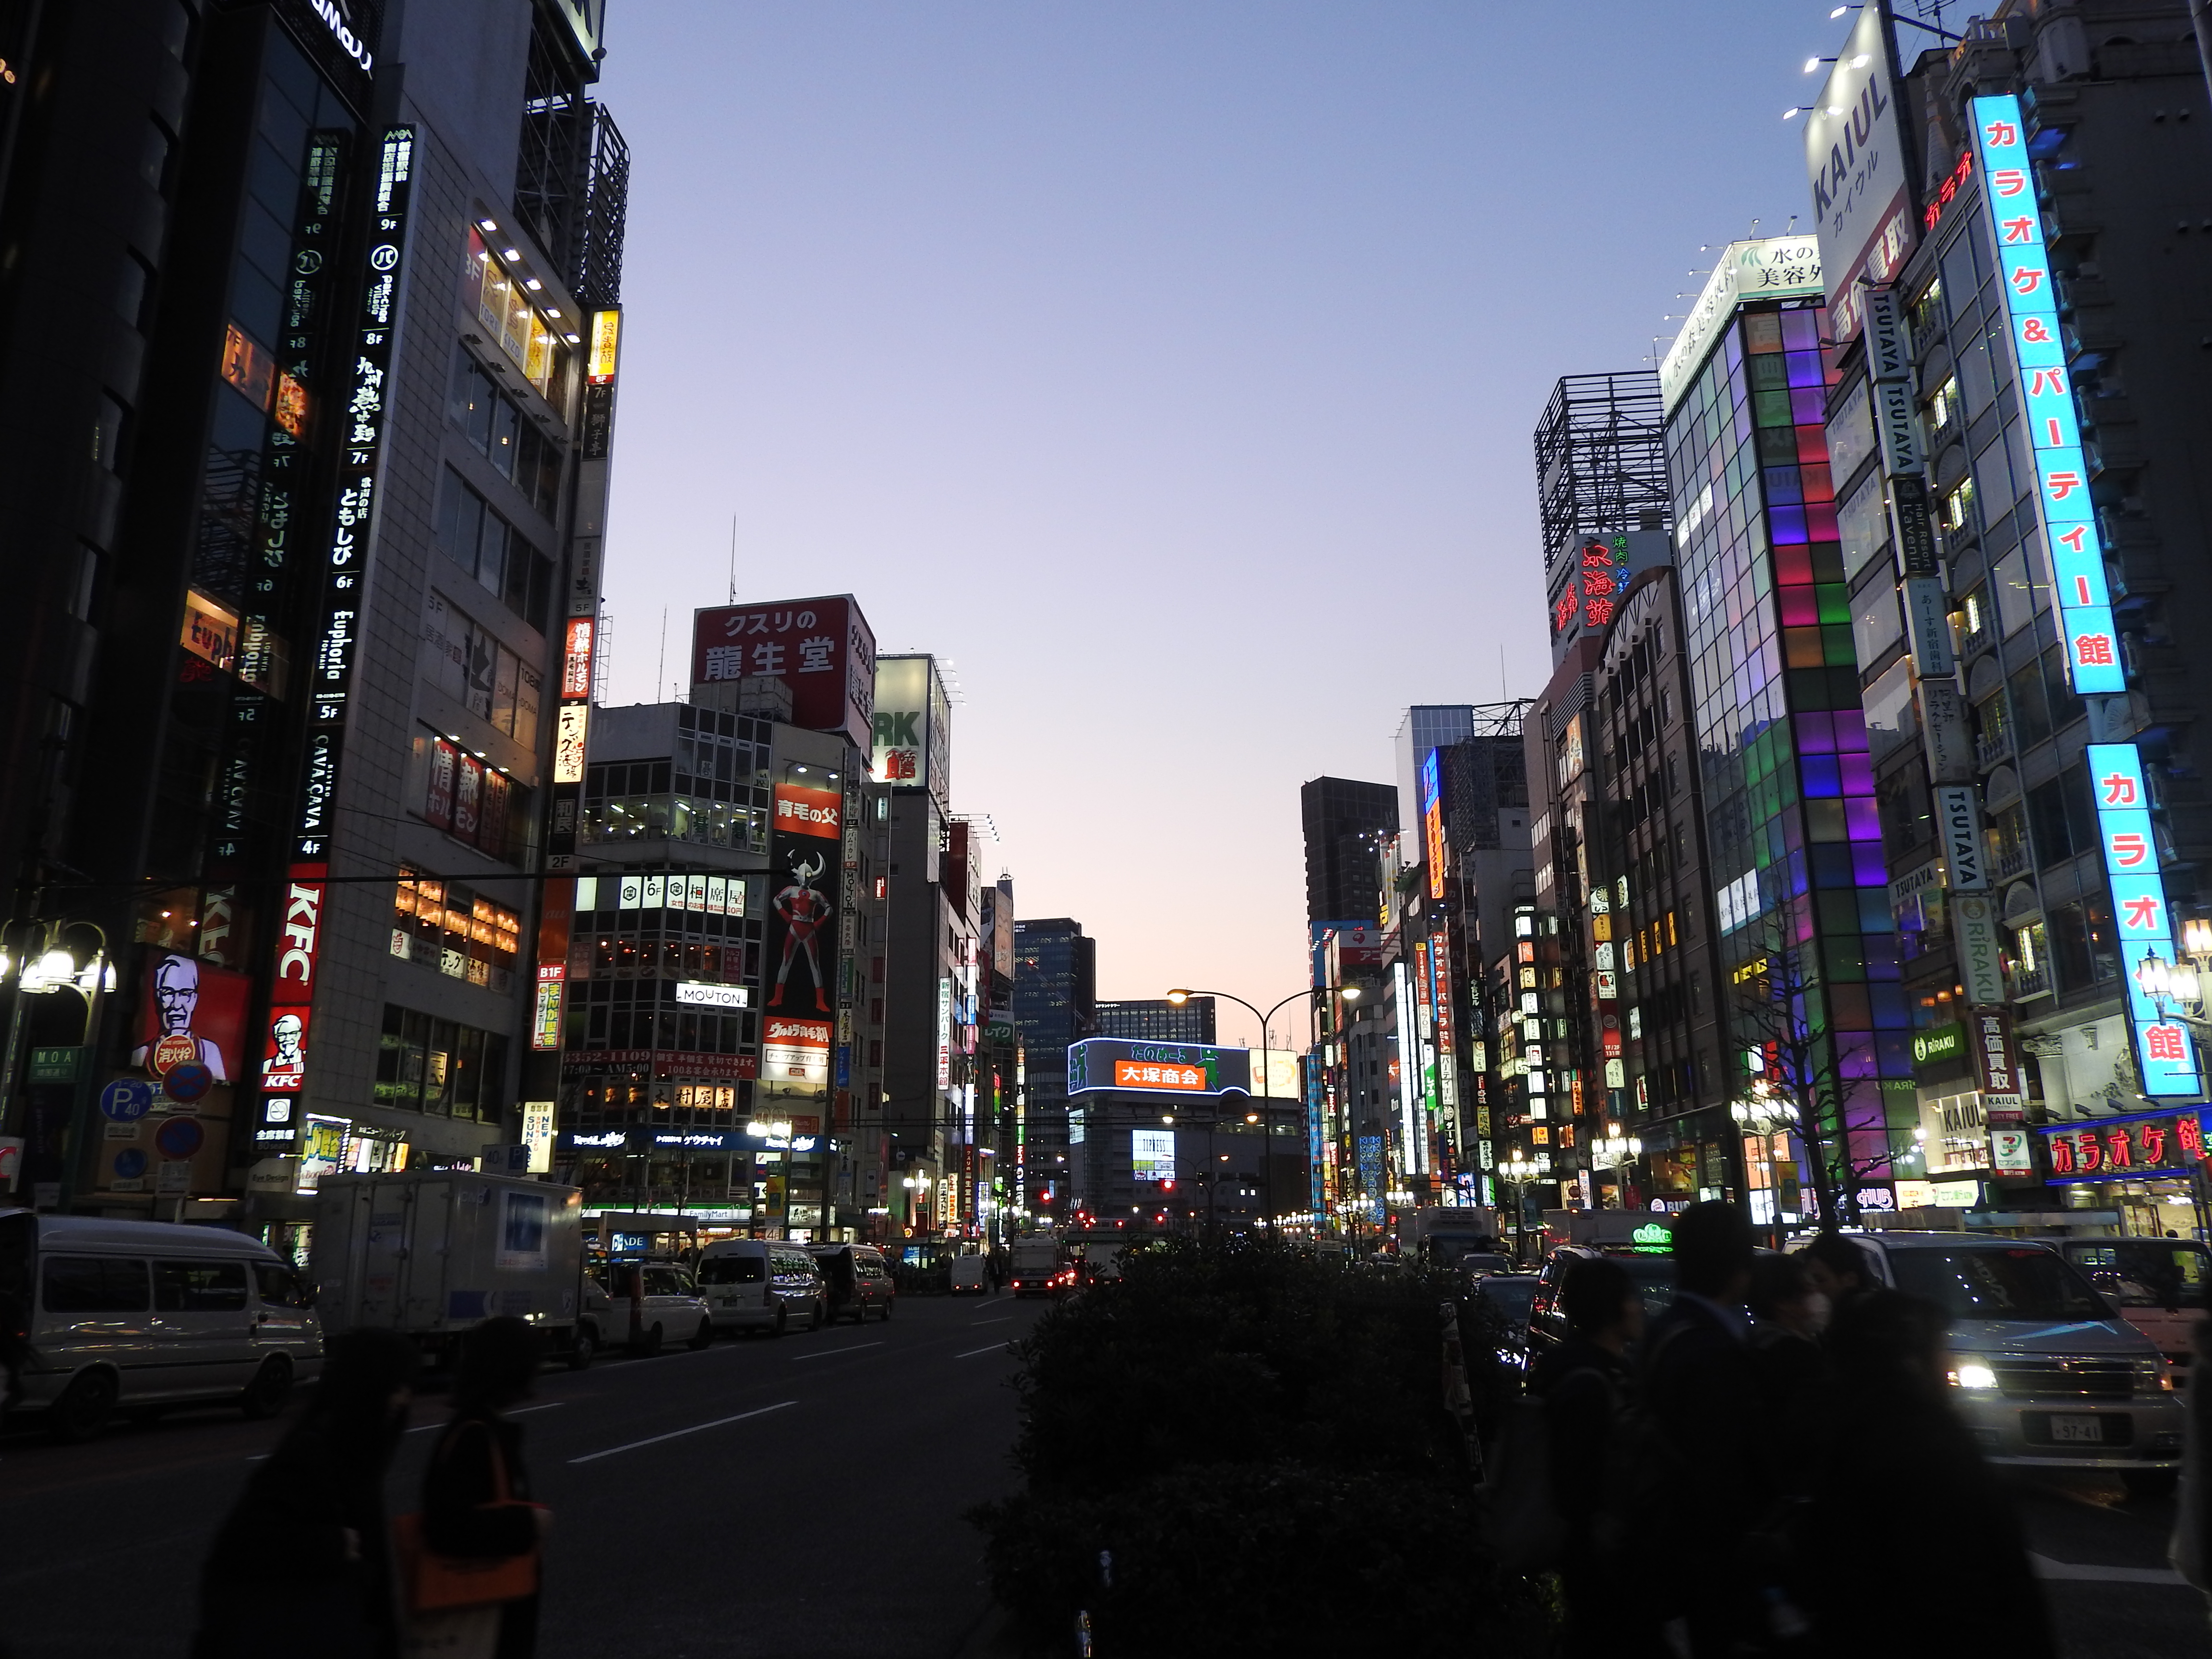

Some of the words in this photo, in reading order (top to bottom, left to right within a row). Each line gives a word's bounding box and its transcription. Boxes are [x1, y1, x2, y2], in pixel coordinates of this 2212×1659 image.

[1813, 72, 1887, 224] KAIUL
[381, 219, 397, 230] 9F
[1771, 245, 1821, 264] 水の
[366, 333, 383, 345] 8F
[1873, 294, 1899, 373] TSUTAYA
[1887, 387, 1914, 469] TSUTAYA
[352, 452, 369, 464] 7F
[332, 488, 358, 565] ともしび
[1915, 504, 1924, 529] Hair
[1919, 530, 1932, 570] Resort
[336, 574, 353, 589] 6F
[724, 611, 817, 637] クスリの
[327, 610, 354, 680] Euphoria
[574, 623, 591, 692] 情熱ホルモン
[704, 636, 835, 681] 龍生堂
[319, 706, 338, 719] 5F
[556, 801, 574, 832] 和民
[777, 799, 838, 827] 育毛の父
[302, 840, 320, 854] 4F
[1948, 791, 1977, 885] TSUTAYA
[552, 856, 569, 868] 2F
[647, 883, 661, 896] 6F
[1895, 866, 1934, 899] TSUTAYA
[689, 884, 744, 905] 相席屋
[280, 882, 320, 982] KFC
[1434, 935, 1445, 979] カラオケ
[540, 967, 562, 978] B1F
[684, 989, 741, 1004] MOUTON
[941, 981, 950, 1041] 新宿サンパーク
[767, 1022, 829, 1044] ウルトラ育毛剤
[985, 1026, 1011, 1038] レイク
[158, 1047, 192, 1064] 消火栓
[1981, 1015, 2011, 1090] 高価買取
[938, 1045, 949, 1087] 三平本館
[1121, 1066, 1199, 1085] 大塚商会
[264, 1074, 302, 1088] KFC
[1426, 1076, 1435, 1096] レイク
[111, 1088, 133, 1115] P
[124, 1103, 140, 1116] 40
[1987, 1096, 2018, 1105] KAIUL
[541, 1116, 550, 1138] NEW
[1944, 1104, 1984, 1132] KAIUL
[255, 1129, 296, 1141] 全席禁煙
[2052, 1118, 2208, 1172] カラオケ館
[1856, 1188, 1893, 1208] HUB
[689, 1210, 728, 1218] FamilyMart
